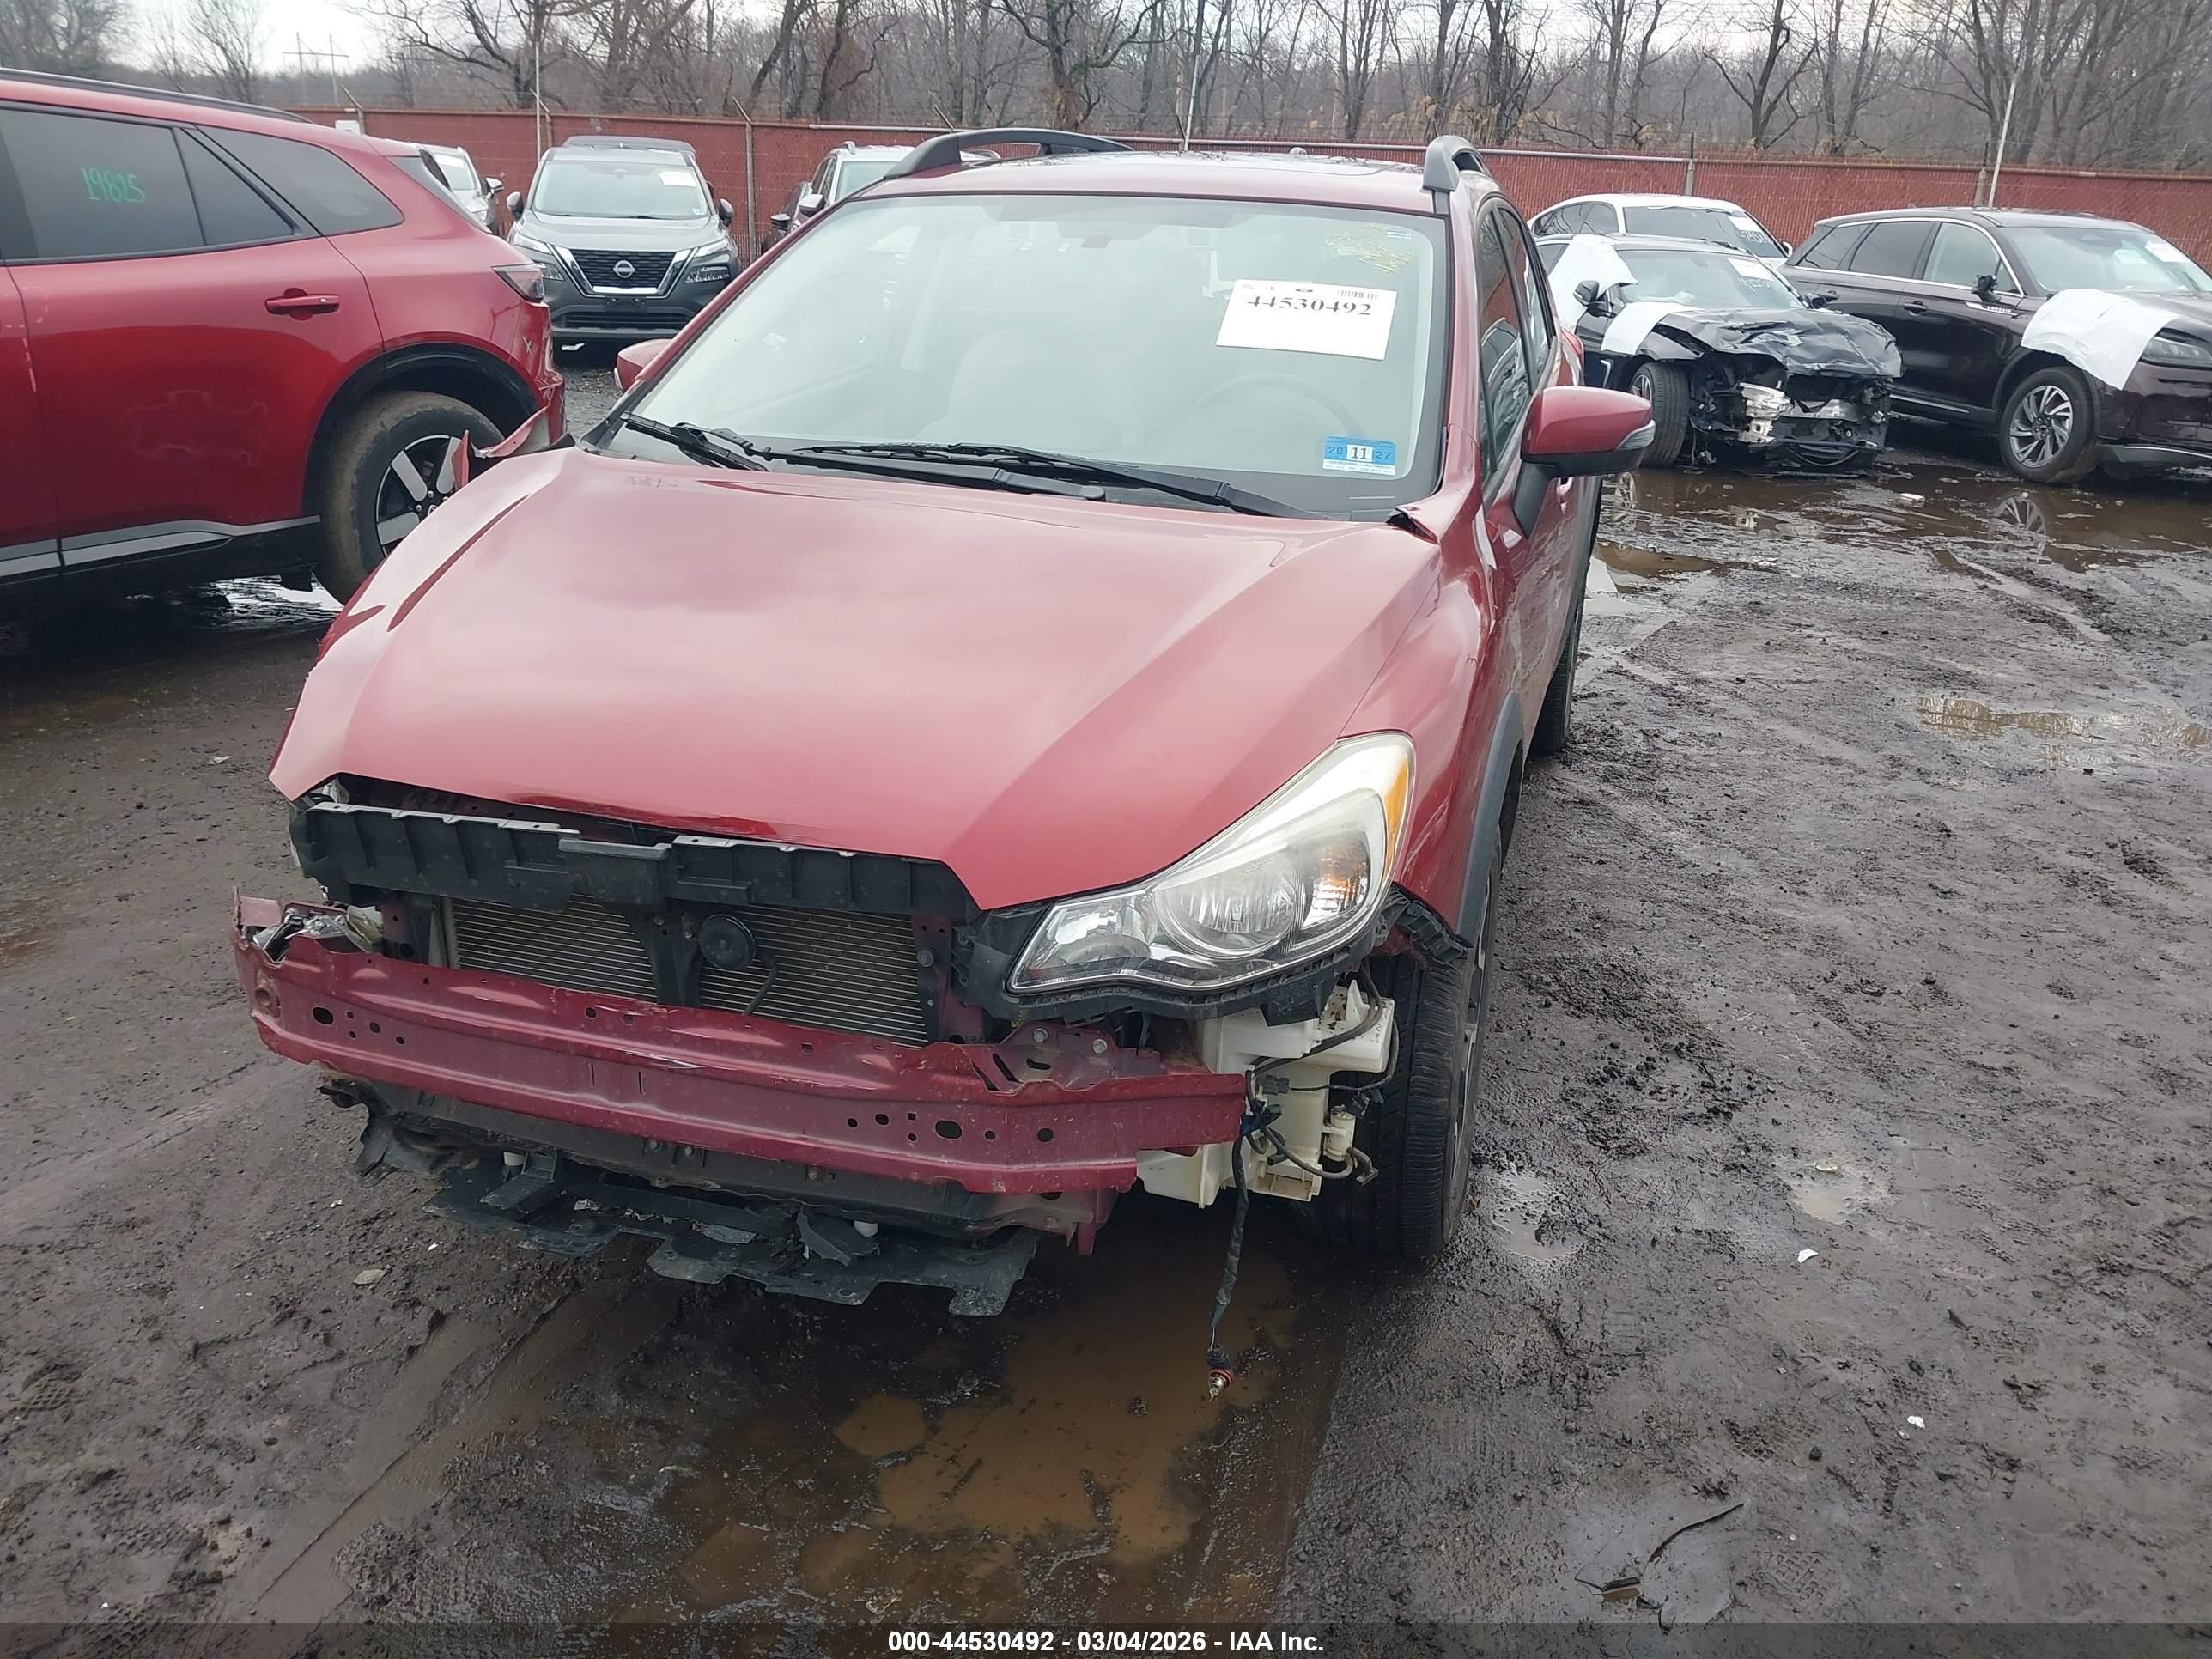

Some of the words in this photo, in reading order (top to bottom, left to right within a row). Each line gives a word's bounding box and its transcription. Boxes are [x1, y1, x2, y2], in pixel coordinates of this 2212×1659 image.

[1247, 295, 1372, 315] 44530492
[1328, 446, 1344, 455] 20
[1352, 447, 1368, 459] 11
[1375, 451, 1392, 459] 27
